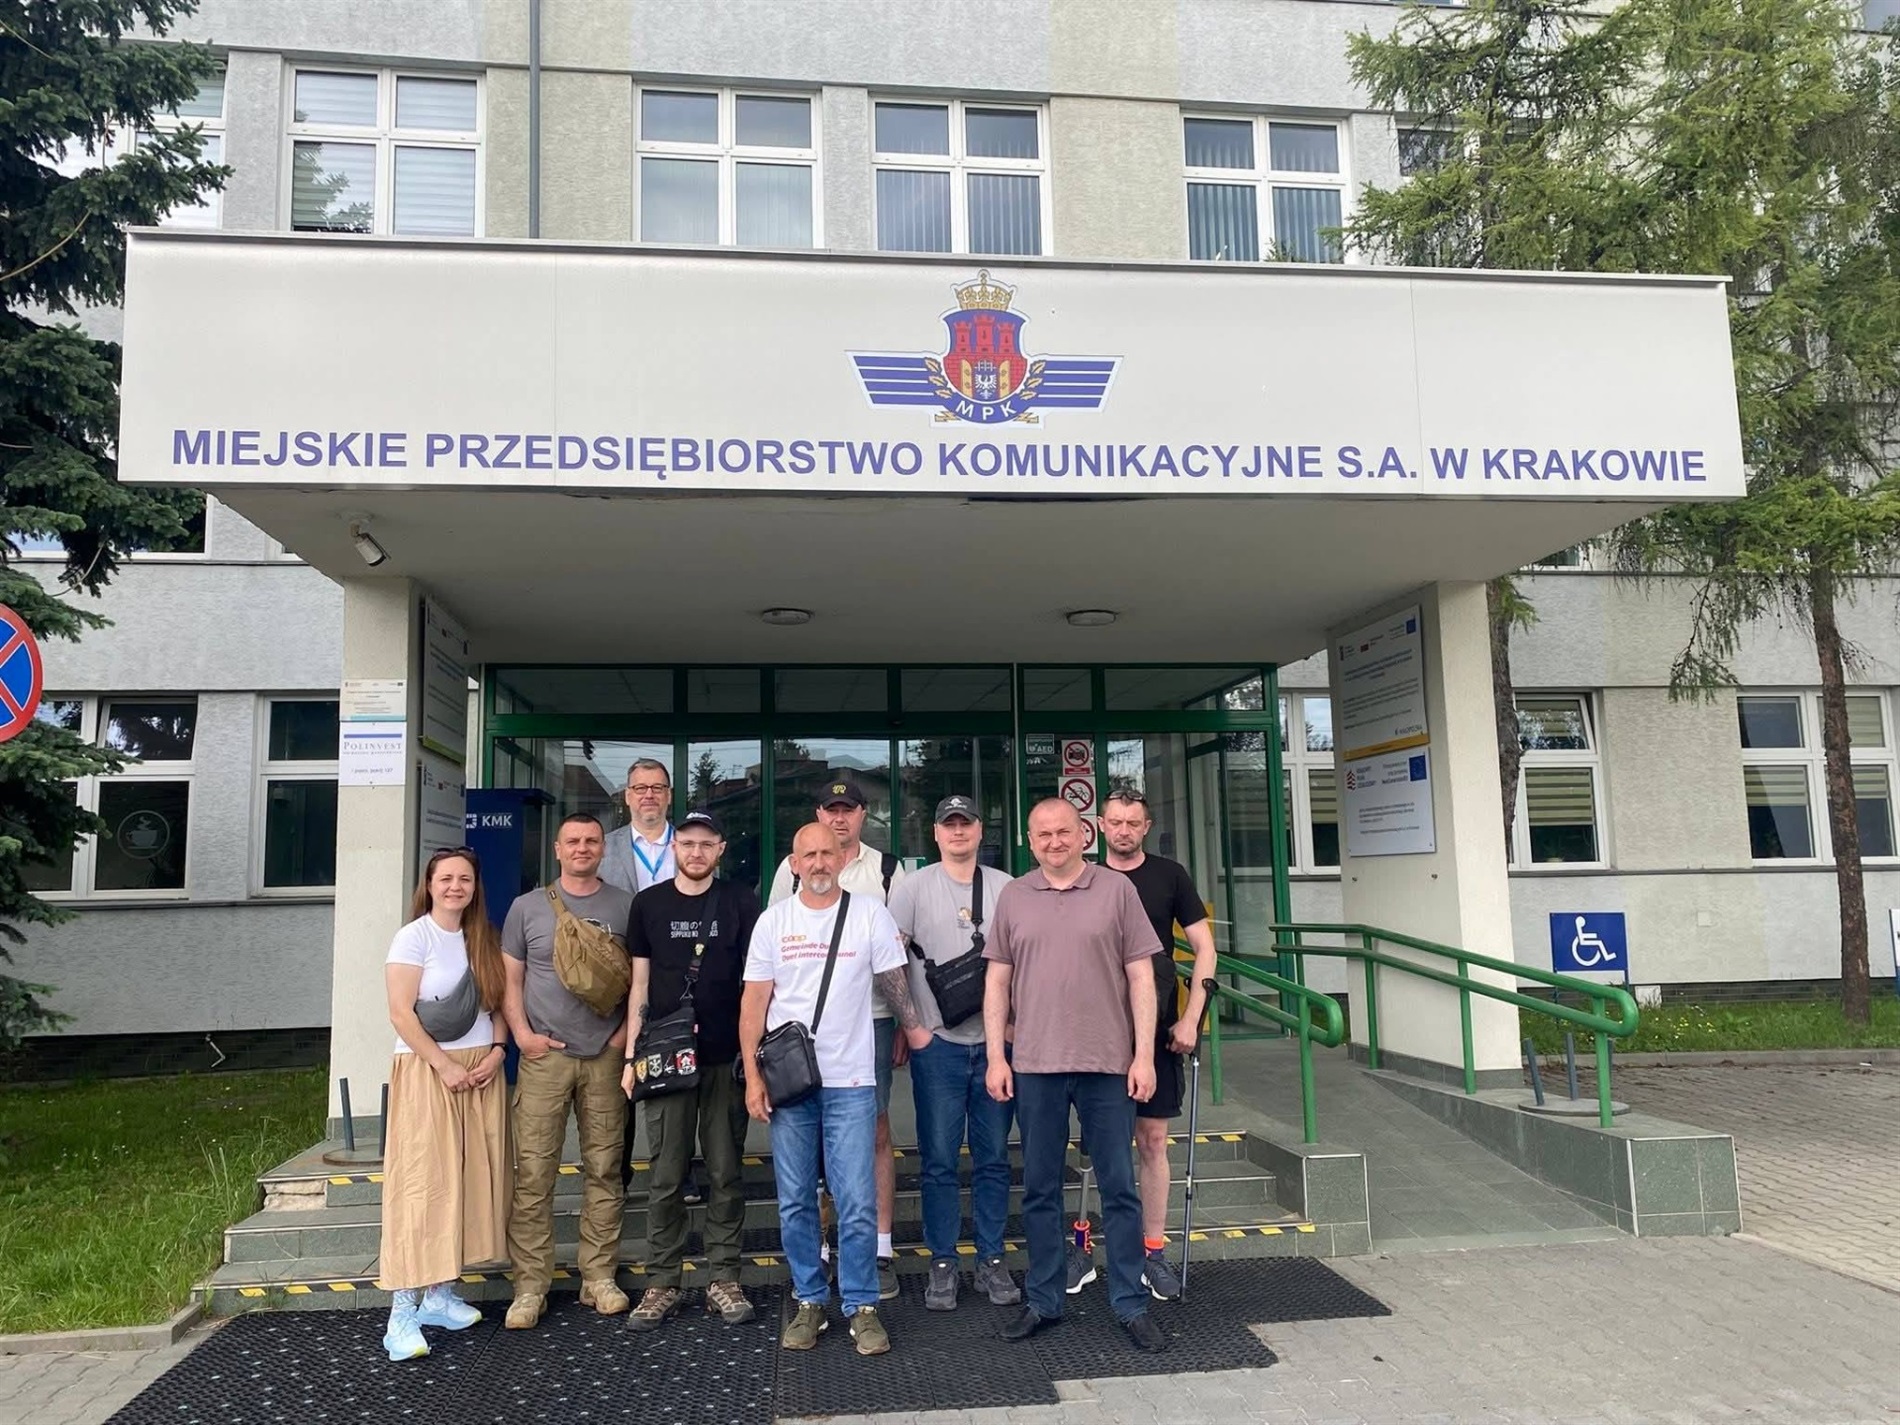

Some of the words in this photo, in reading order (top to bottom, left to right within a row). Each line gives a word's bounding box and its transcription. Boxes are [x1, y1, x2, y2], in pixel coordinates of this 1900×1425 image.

[955, 400, 1017, 421] MPK
[173, 430, 407, 466] MIEJSKIE
[426, 434, 923, 478] PRZEDSIĘBIORSTWO
[938, 443, 1321, 478] KOMUNIKACYJNE
[1338, 446, 1418, 478] S.A.
[1432, 448, 1468, 479] W
[1483, 448, 1706, 481] KRAKOWIE
[482, 815, 512, 827] KMK
